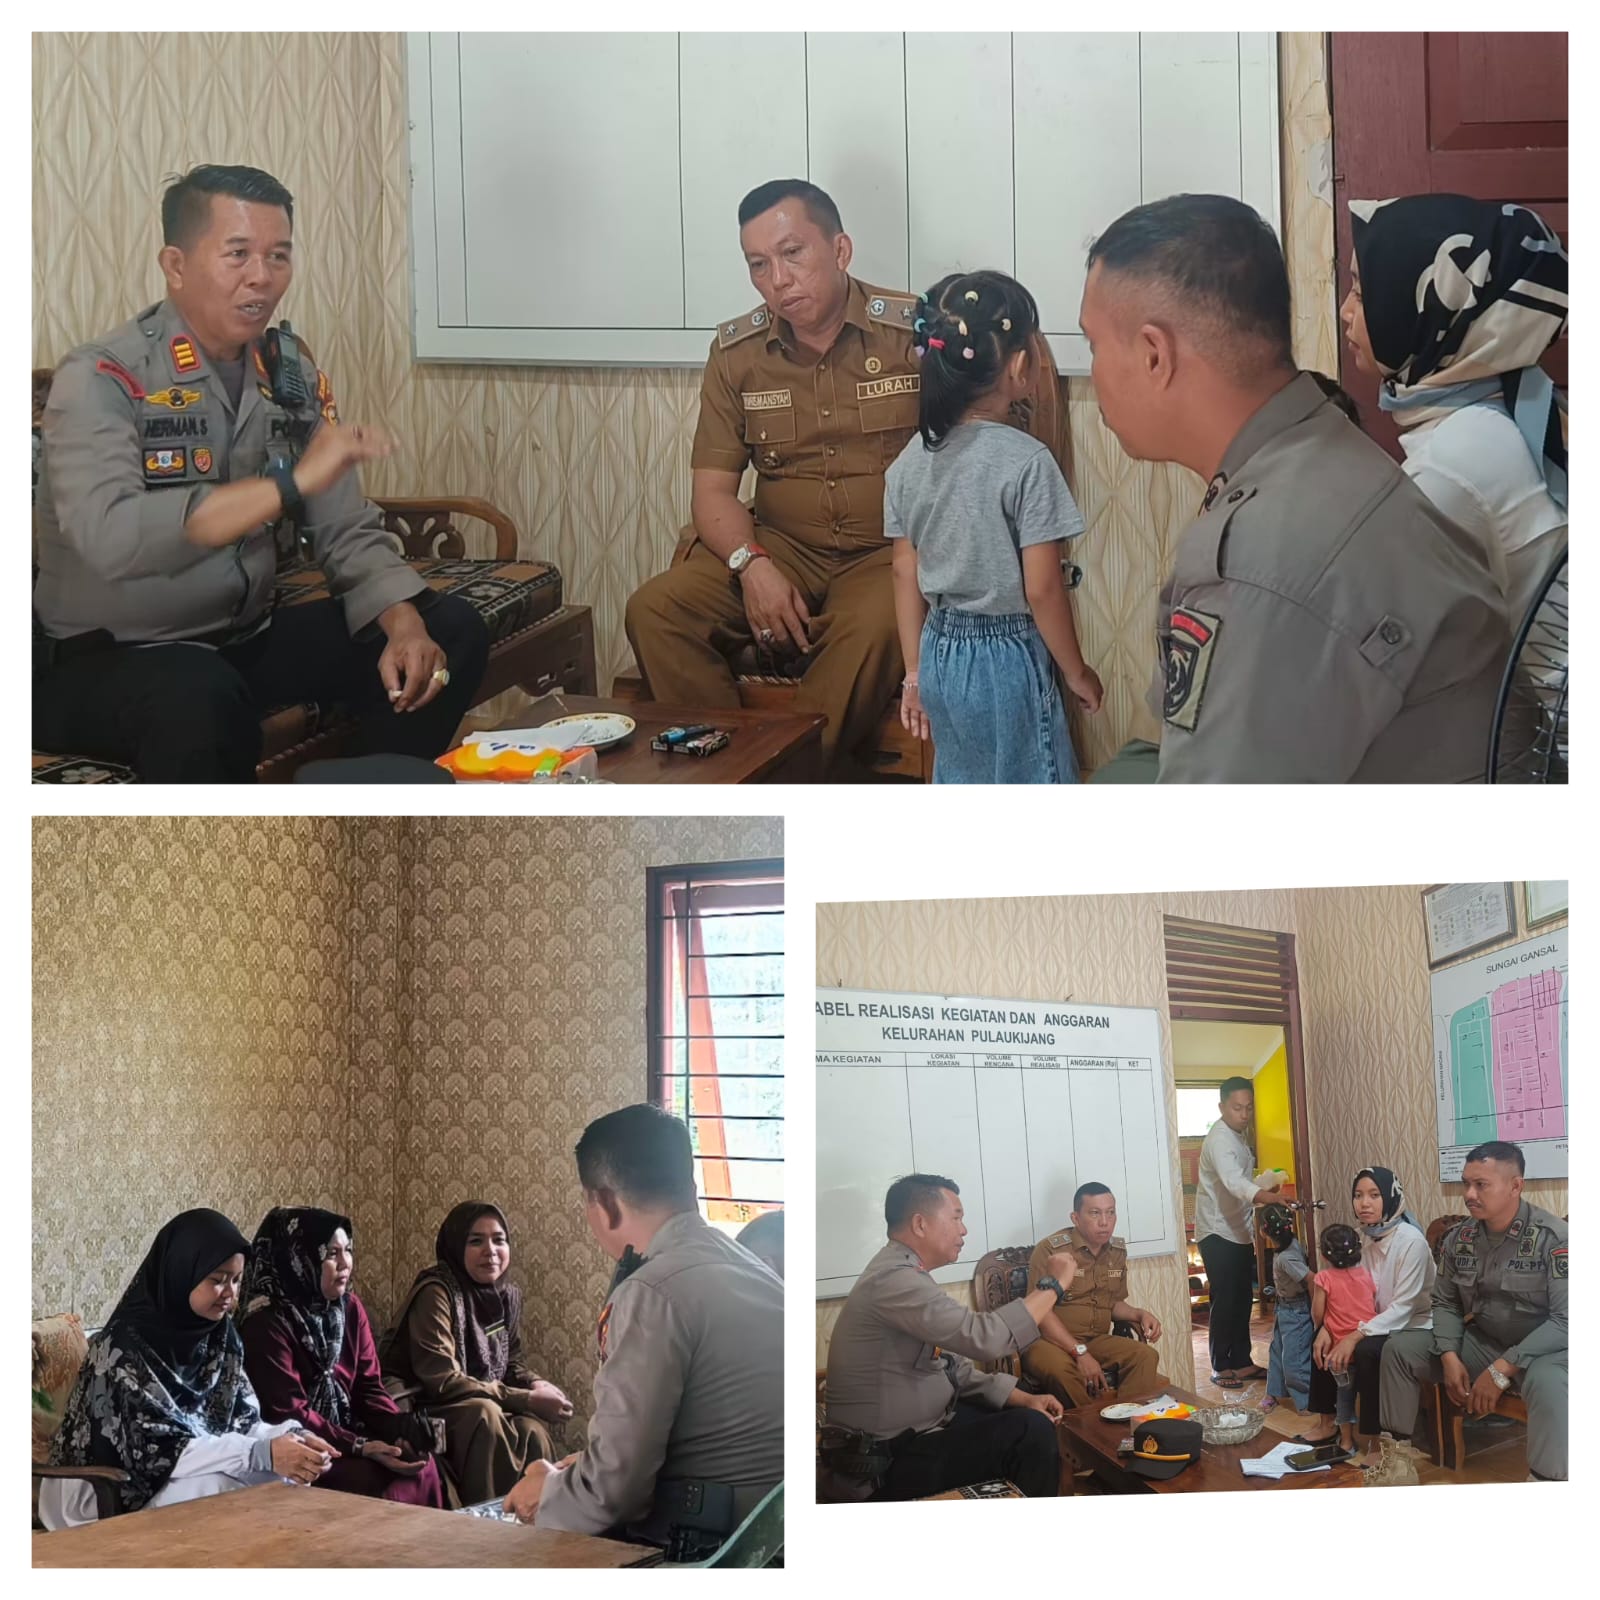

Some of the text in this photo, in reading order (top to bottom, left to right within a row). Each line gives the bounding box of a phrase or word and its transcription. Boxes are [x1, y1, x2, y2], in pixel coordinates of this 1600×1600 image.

[867, 377, 912, 395] LURAH
[1485, 945, 1559, 974] SUNGAI GANSAL
[816, 1001, 1110, 1028] ABEL REALISASI KEGIATAN DAN ANGGARAN
[882, 1026, 1056, 1046] KELURAHAN PULAUKIJANG
[832, 1055, 882, 1063] KEGIATAN
[1070, 1059, 1104, 1067] ANGGARAN
[1128, 1060, 1139, 1068] KET
